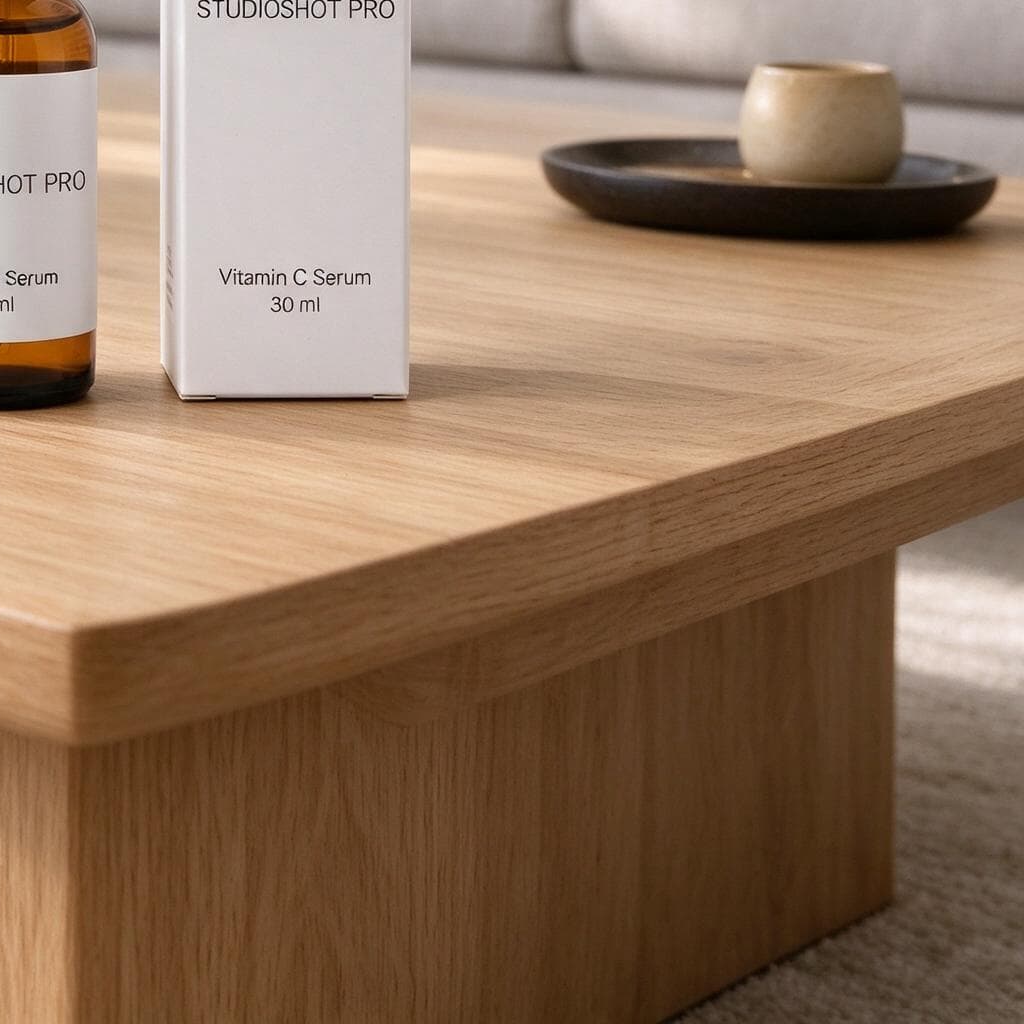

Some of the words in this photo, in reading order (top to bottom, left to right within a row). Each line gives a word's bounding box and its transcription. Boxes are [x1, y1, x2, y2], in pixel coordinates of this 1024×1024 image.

[44, 169, 87, 194] PRO
[4, 269, 59, 287] Serum
[218, 267, 287, 287] Vitamin
[292, 268, 308, 287] C
[312, 268, 371, 287] Serum
[270, 295, 295, 313] 30
[299, 296, 320, 313] ml
